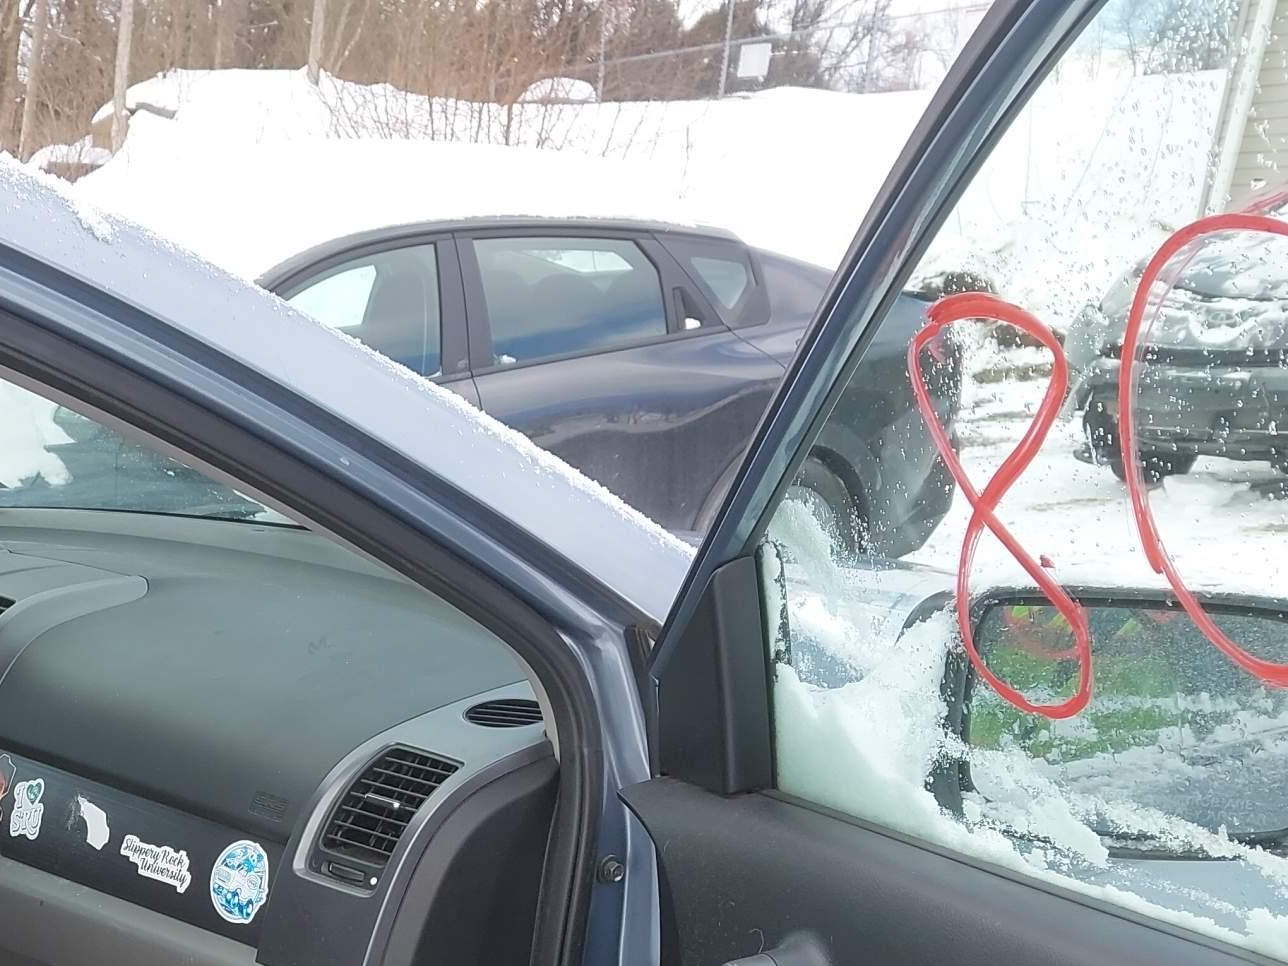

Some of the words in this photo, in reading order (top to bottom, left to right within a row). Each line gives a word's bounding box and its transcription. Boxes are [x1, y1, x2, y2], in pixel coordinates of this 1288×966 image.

[123, 838, 161, 865] Slippery
[160, 849, 187, 869] Rock
[140, 857, 188, 888] University
